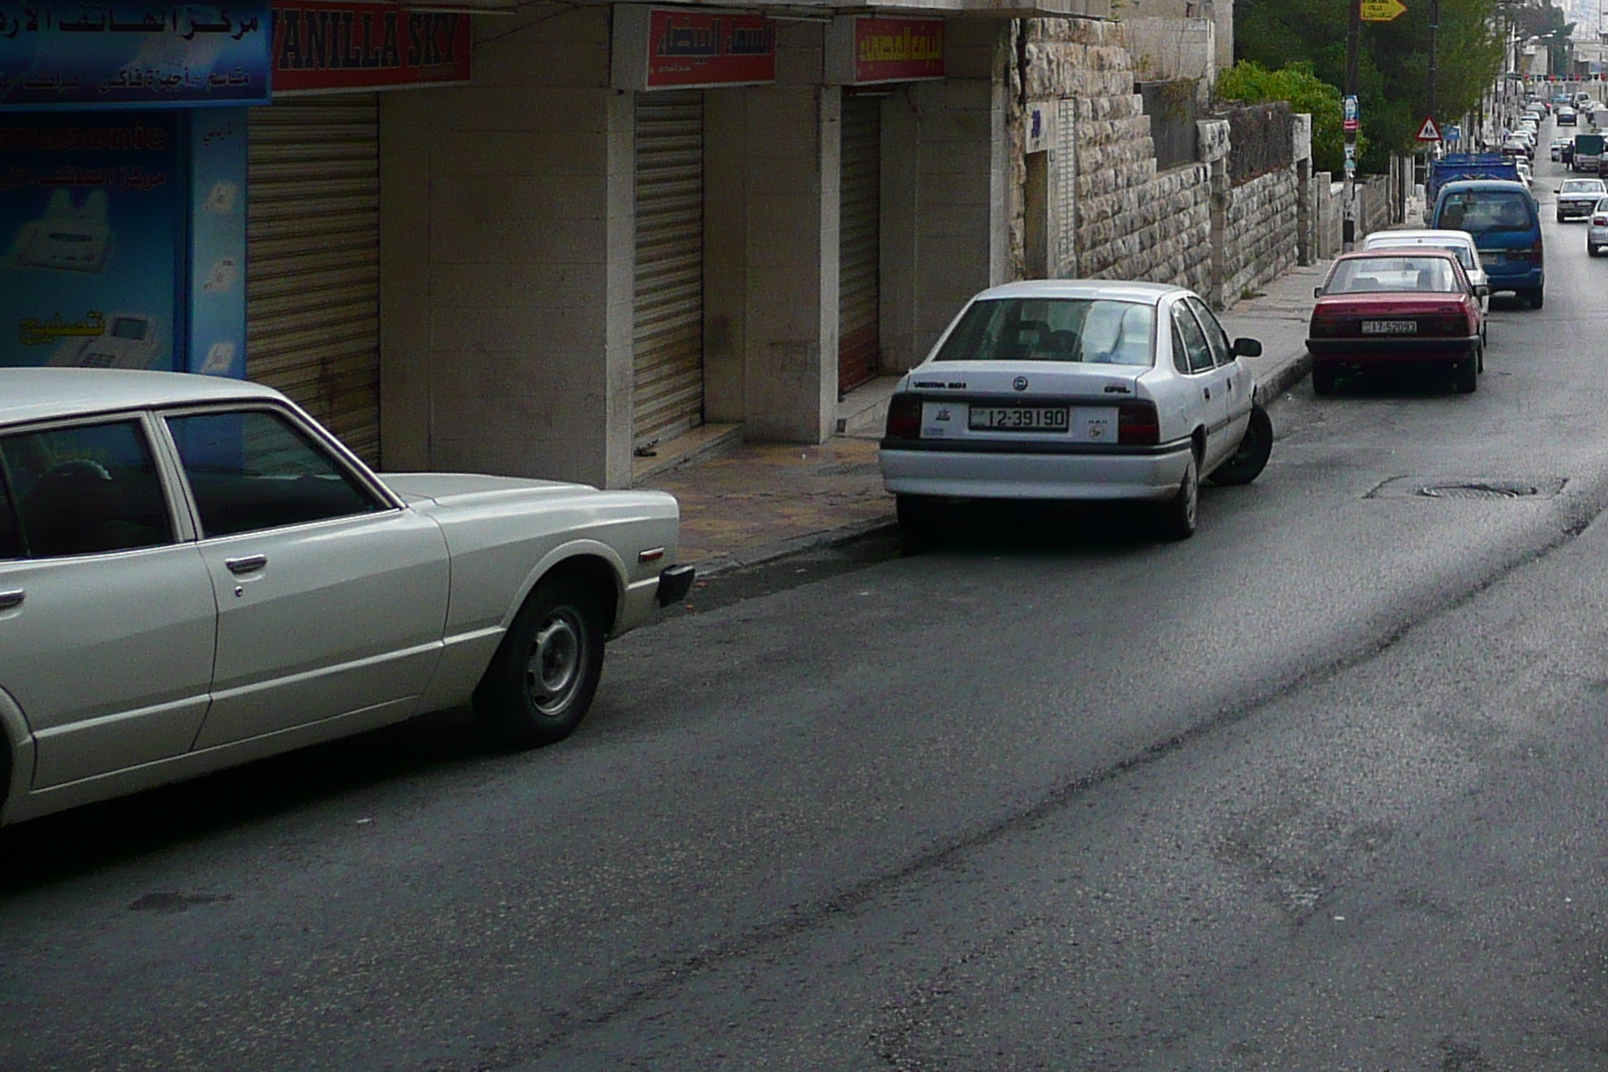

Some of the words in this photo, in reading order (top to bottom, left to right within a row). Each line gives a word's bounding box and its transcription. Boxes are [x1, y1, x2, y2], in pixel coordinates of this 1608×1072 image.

[58, 1, 177, 33] الهاتف
[181, 5, 260, 41] مركز
[407, 11, 459, 69] SKY
[21, 310, 106, 345] تصليح
[988, 410, 1065, 427] 12-39190
